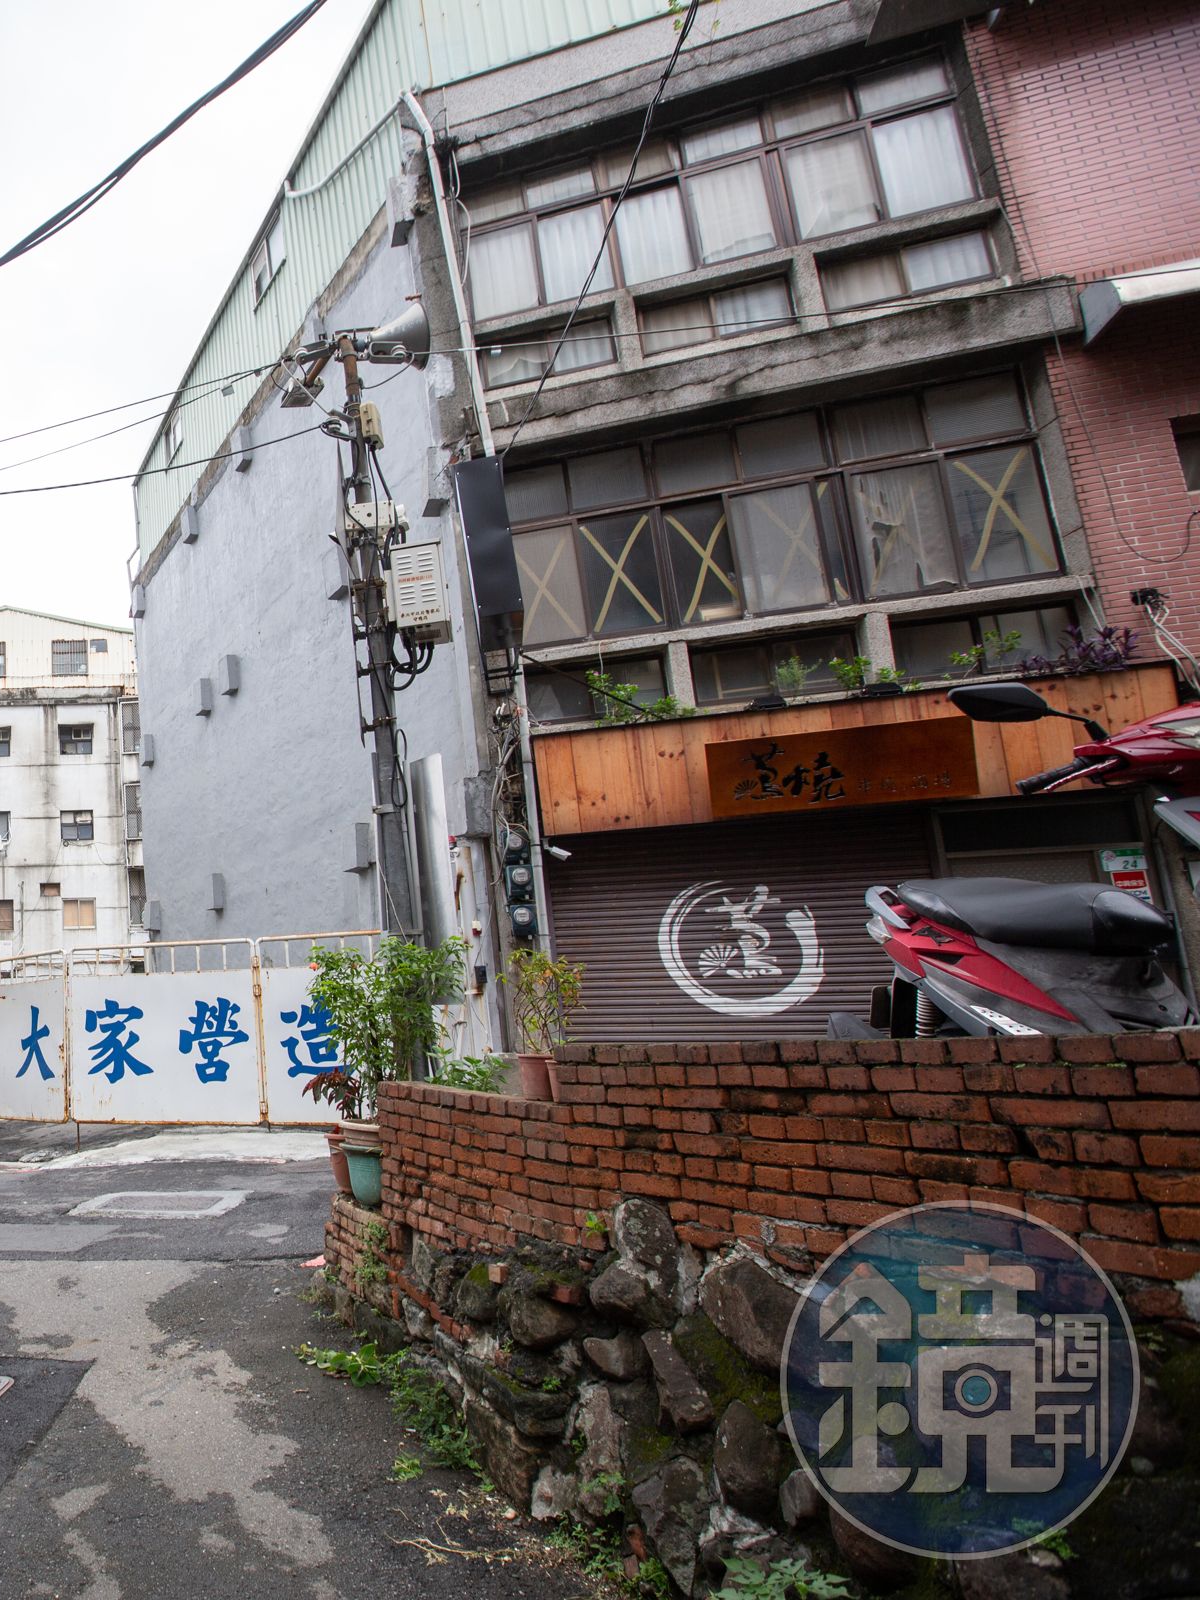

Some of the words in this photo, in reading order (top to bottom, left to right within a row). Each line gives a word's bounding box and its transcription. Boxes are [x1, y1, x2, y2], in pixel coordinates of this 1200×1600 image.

[1122, 860, 1138, 870] 24
[16, 995, 356, 1084] 大家營造
